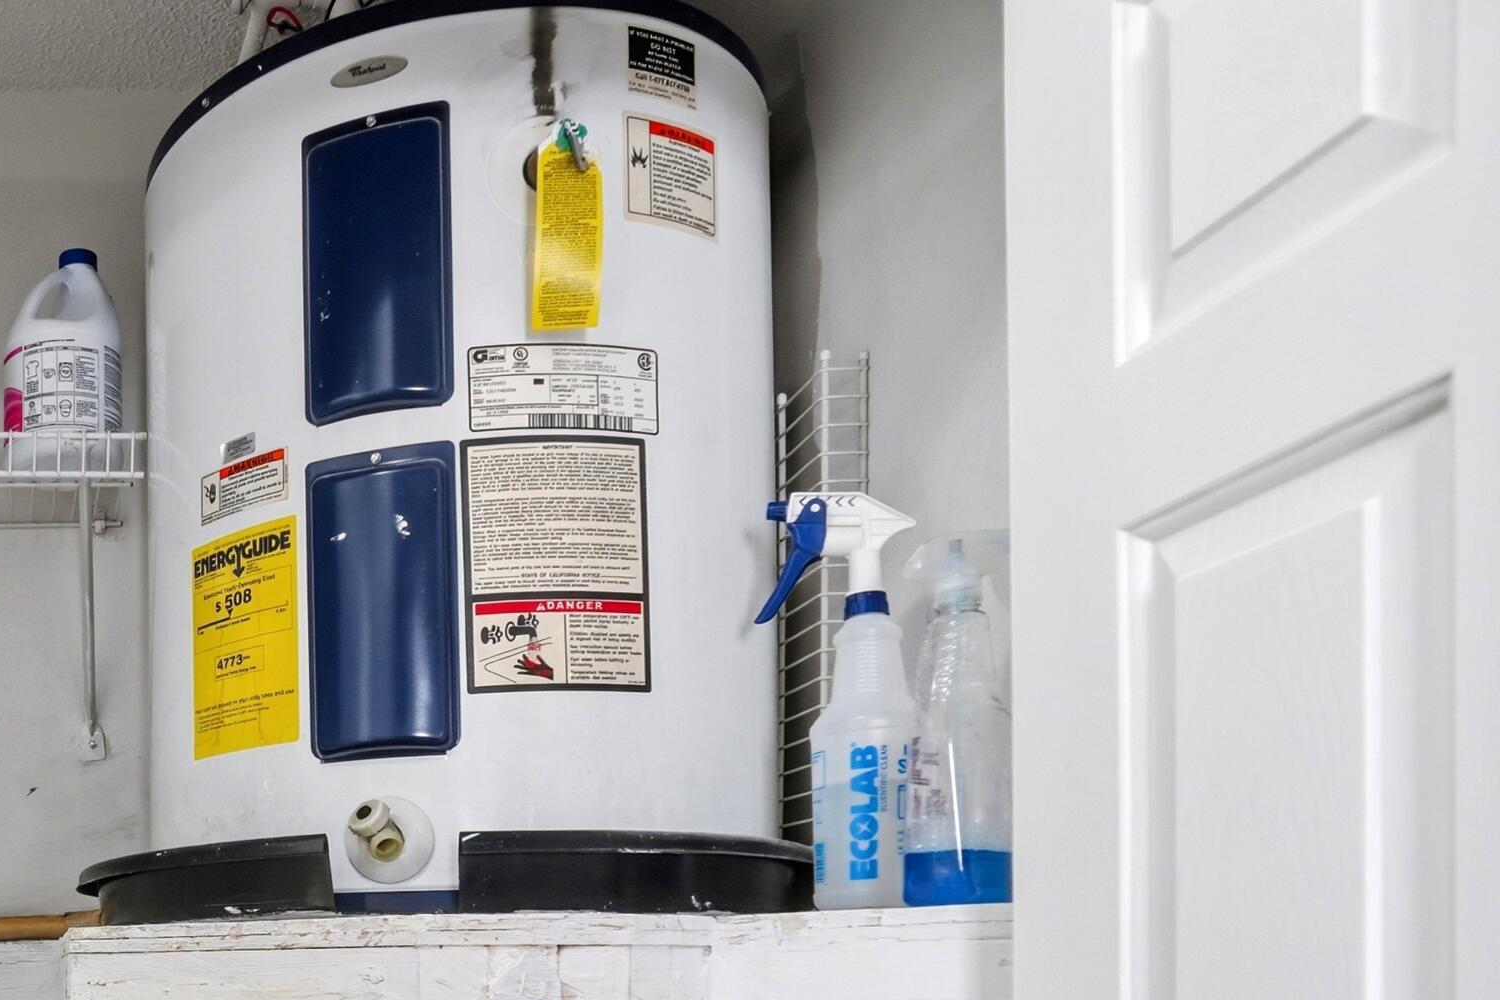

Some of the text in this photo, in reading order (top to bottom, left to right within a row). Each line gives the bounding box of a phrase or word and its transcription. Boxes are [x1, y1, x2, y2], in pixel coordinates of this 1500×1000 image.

[194, 530, 291, 579] ENERGYGUIDE
[225, 588, 252, 609] 508
[546, 601, 603, 610] DANGER
[216, 654, 243, 671] 4773
[850, 745, 878, 880] ECOLAB
